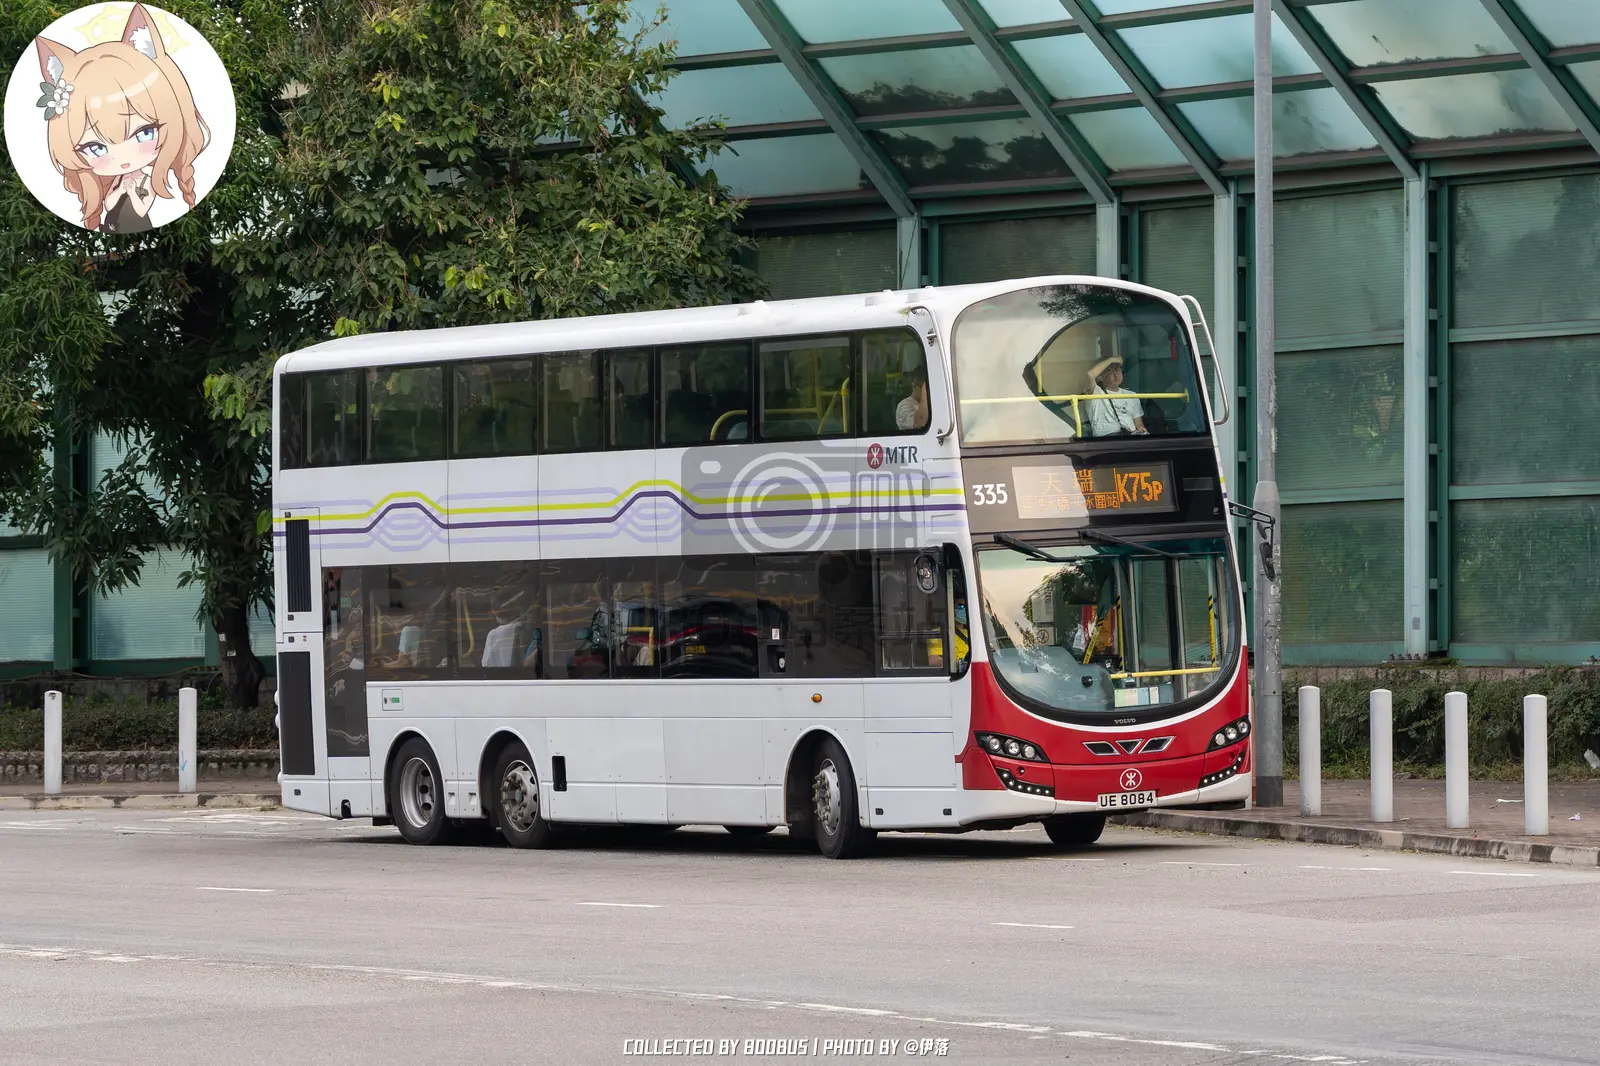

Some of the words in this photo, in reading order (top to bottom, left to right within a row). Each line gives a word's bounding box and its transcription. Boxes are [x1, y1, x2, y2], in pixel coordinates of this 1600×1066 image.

[885, 446, 918, 465] MTR
[972, 483, 1008, 506] 335
[1100, 796, 1117, 807] UE
[1120, 792, 1153, 806] 8084
